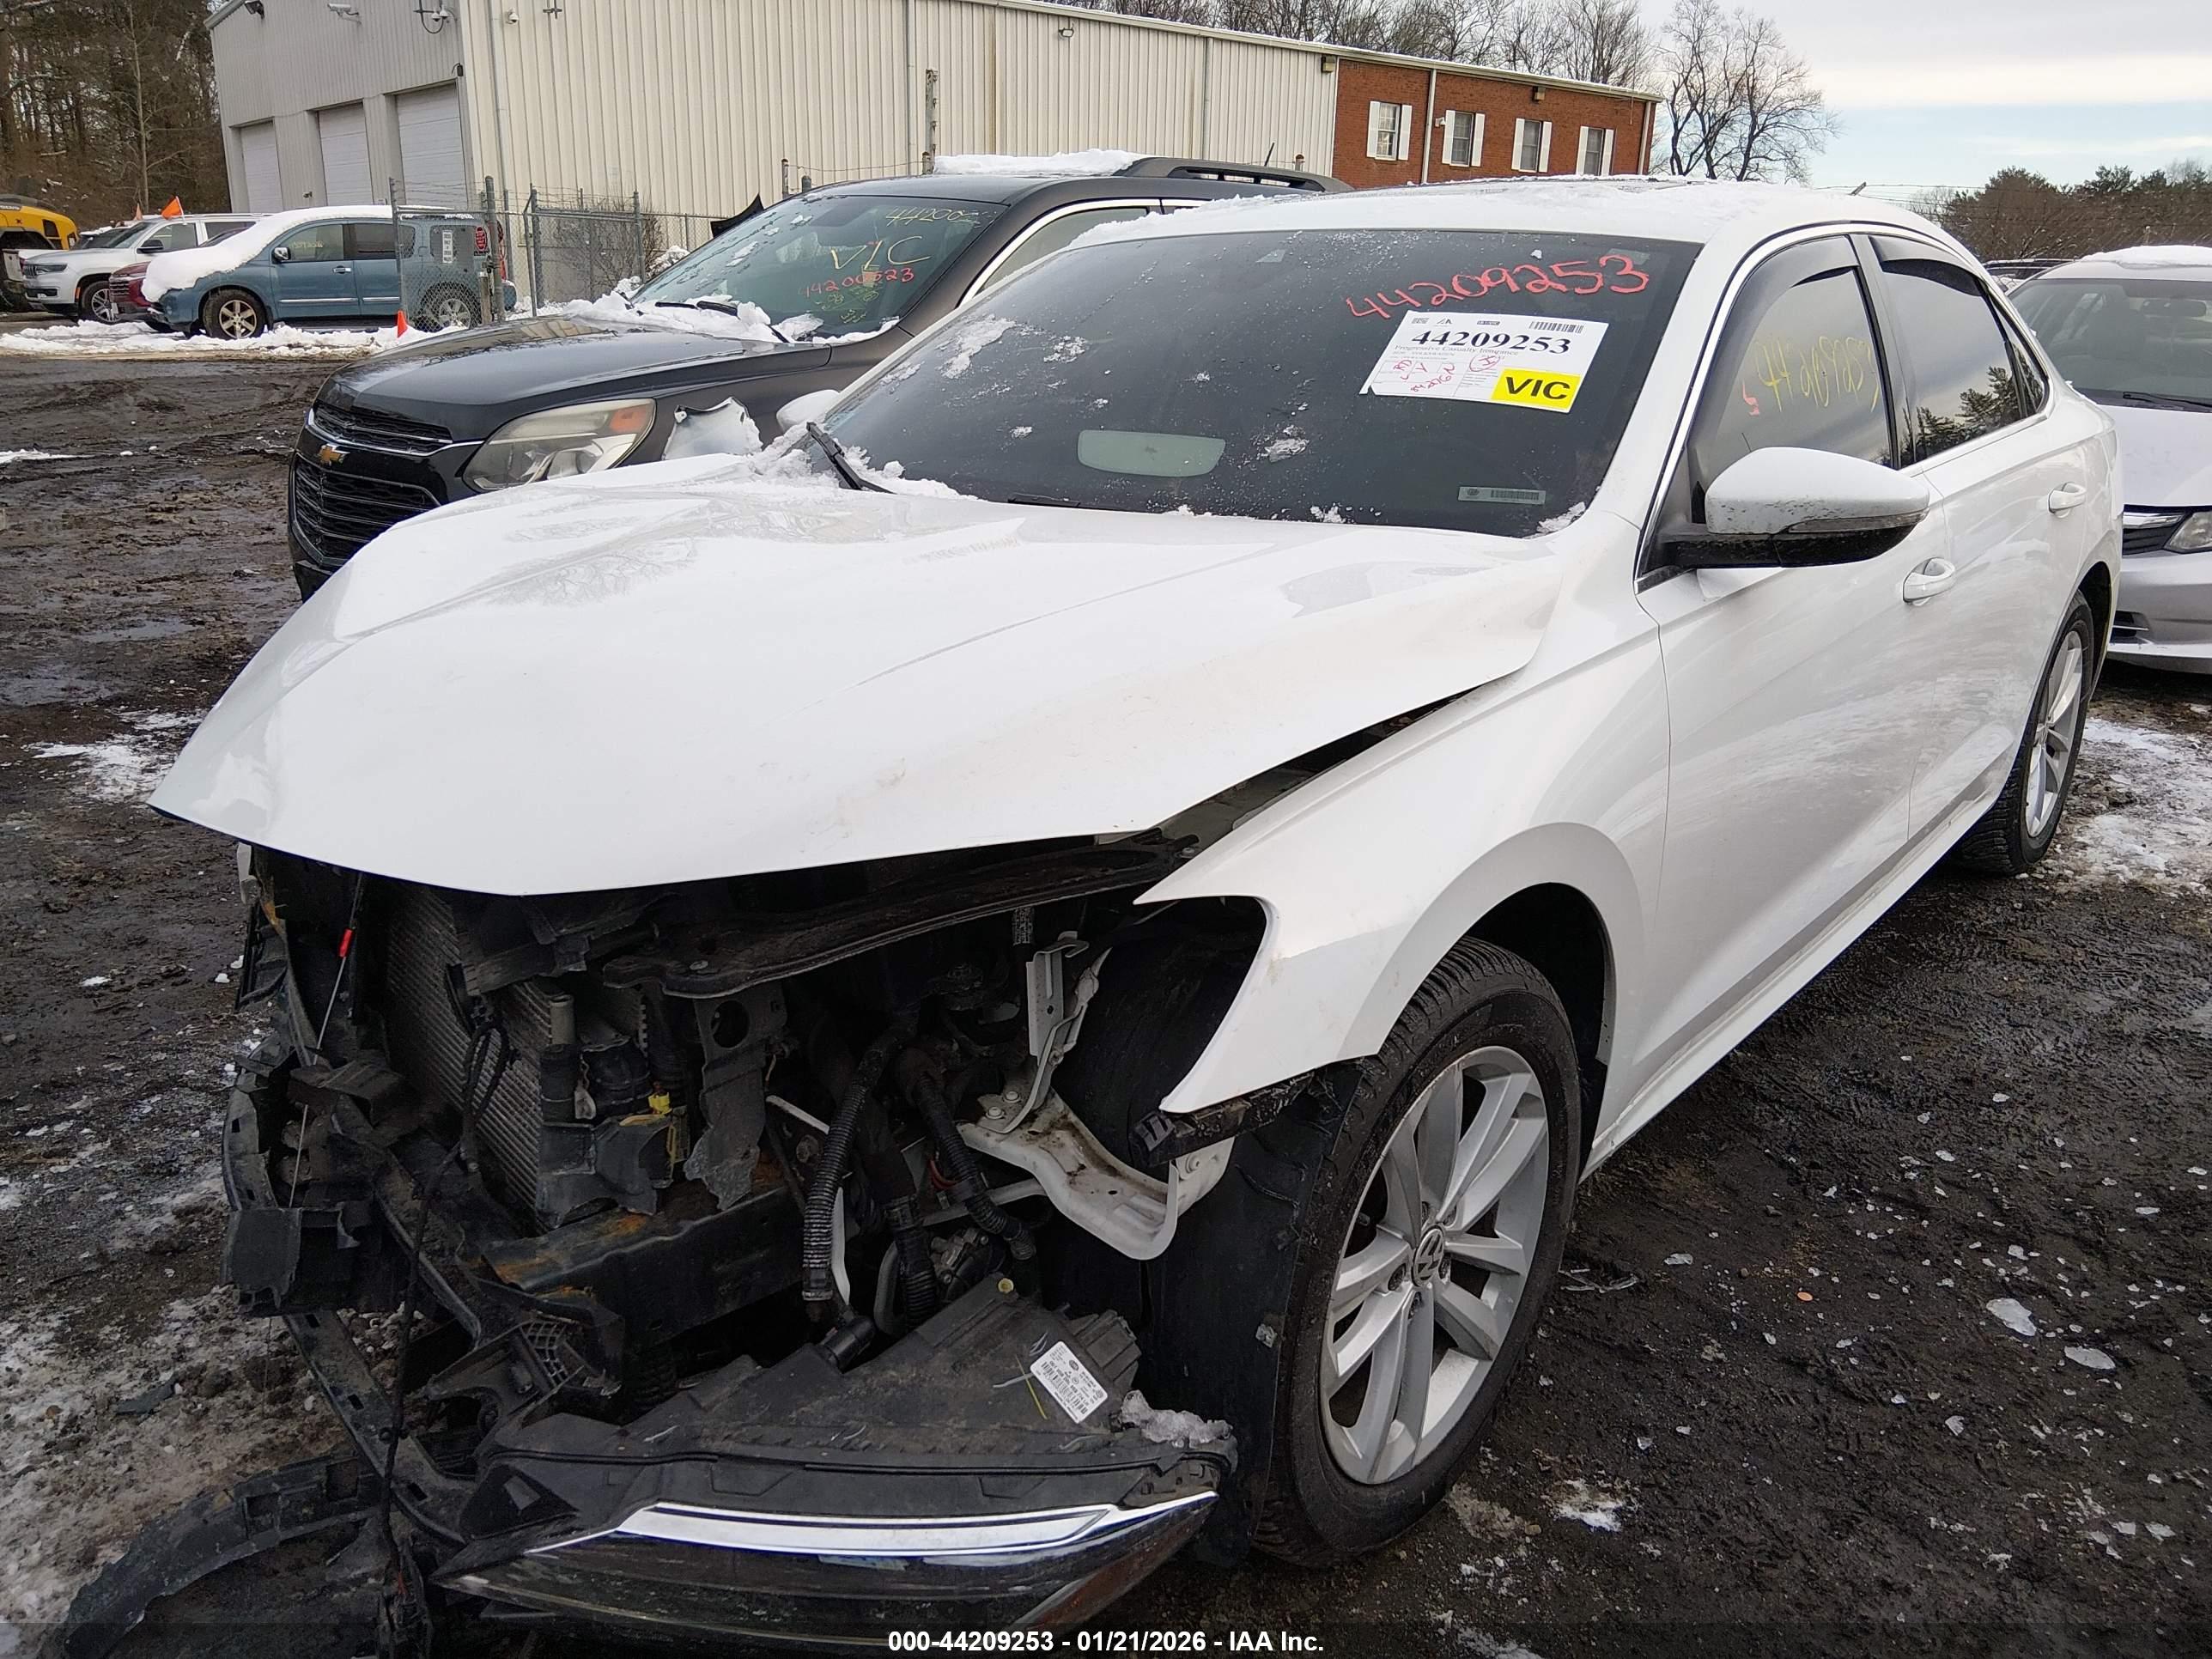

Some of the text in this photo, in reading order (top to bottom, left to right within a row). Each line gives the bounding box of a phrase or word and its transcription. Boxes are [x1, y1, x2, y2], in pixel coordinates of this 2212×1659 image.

[830, 235, 933, 270] VIC
[1346, 254, 1650, 319] 44209253
[1411, 330, 1571, 355] 44209253
[1505, 376, 1571, 400] VIC
